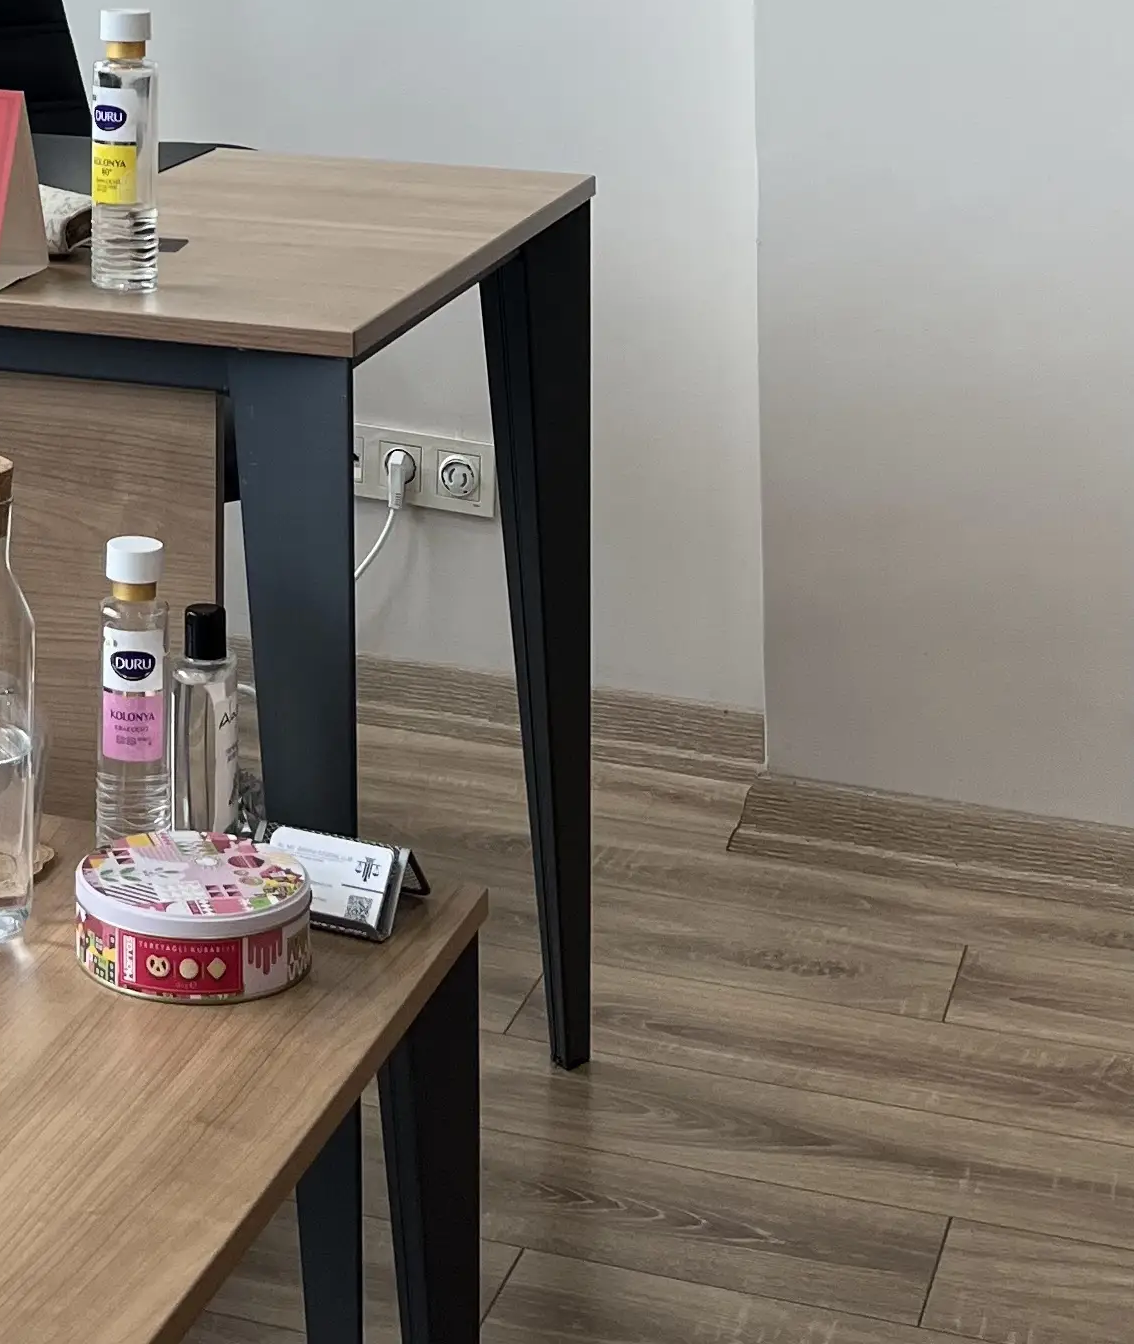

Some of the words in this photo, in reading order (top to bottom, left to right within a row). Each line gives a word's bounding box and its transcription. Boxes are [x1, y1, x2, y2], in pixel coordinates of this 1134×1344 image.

[95, 109, 123, 122] DURU
[115, 656, 152, 671] DURU
[110, 709, 156, 722] KOLONYA
